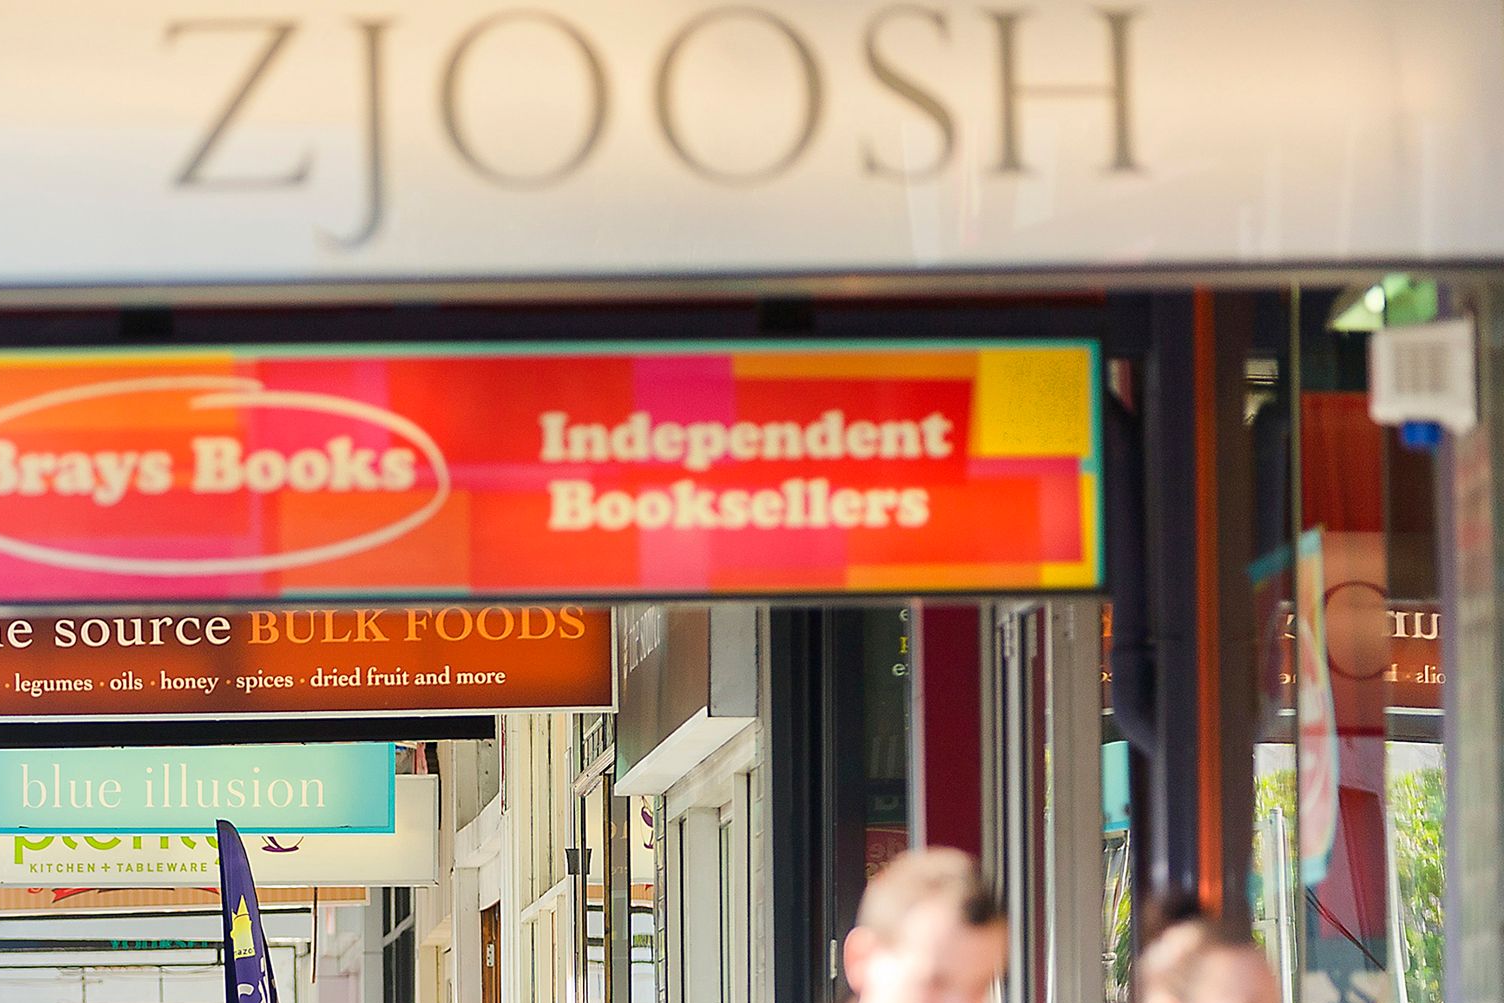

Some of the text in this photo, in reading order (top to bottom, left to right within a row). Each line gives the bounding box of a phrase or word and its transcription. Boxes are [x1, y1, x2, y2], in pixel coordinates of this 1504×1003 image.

[165, 6, 1148, 250] ZJOOSH
[191, 435, 416, 494] Books
[539, 410, 953, 472] Independent
[547, 479, 930, 532] Booksellers
[54, 614, 232, 649] source
[247, 607, 390, 645] BULK
[403, 605, 586, 643] FOODS
[14, 672, 94, 698] legumes
[109, 670, 144, 691] oils
[159, 670, 220, 695] honey
[235, 669, 294, 693] spices
[309, 667, 362, 688] dried
[366, 666, 410, 687] fruit
[414, 665, 451, 687] and
[456, 670, 507, 686] more
[19, 762, 327, 809] blue illusion
[29, 863, 96, 873] KITCHEN
[116, 862, 208, 873] TABLEWARE
